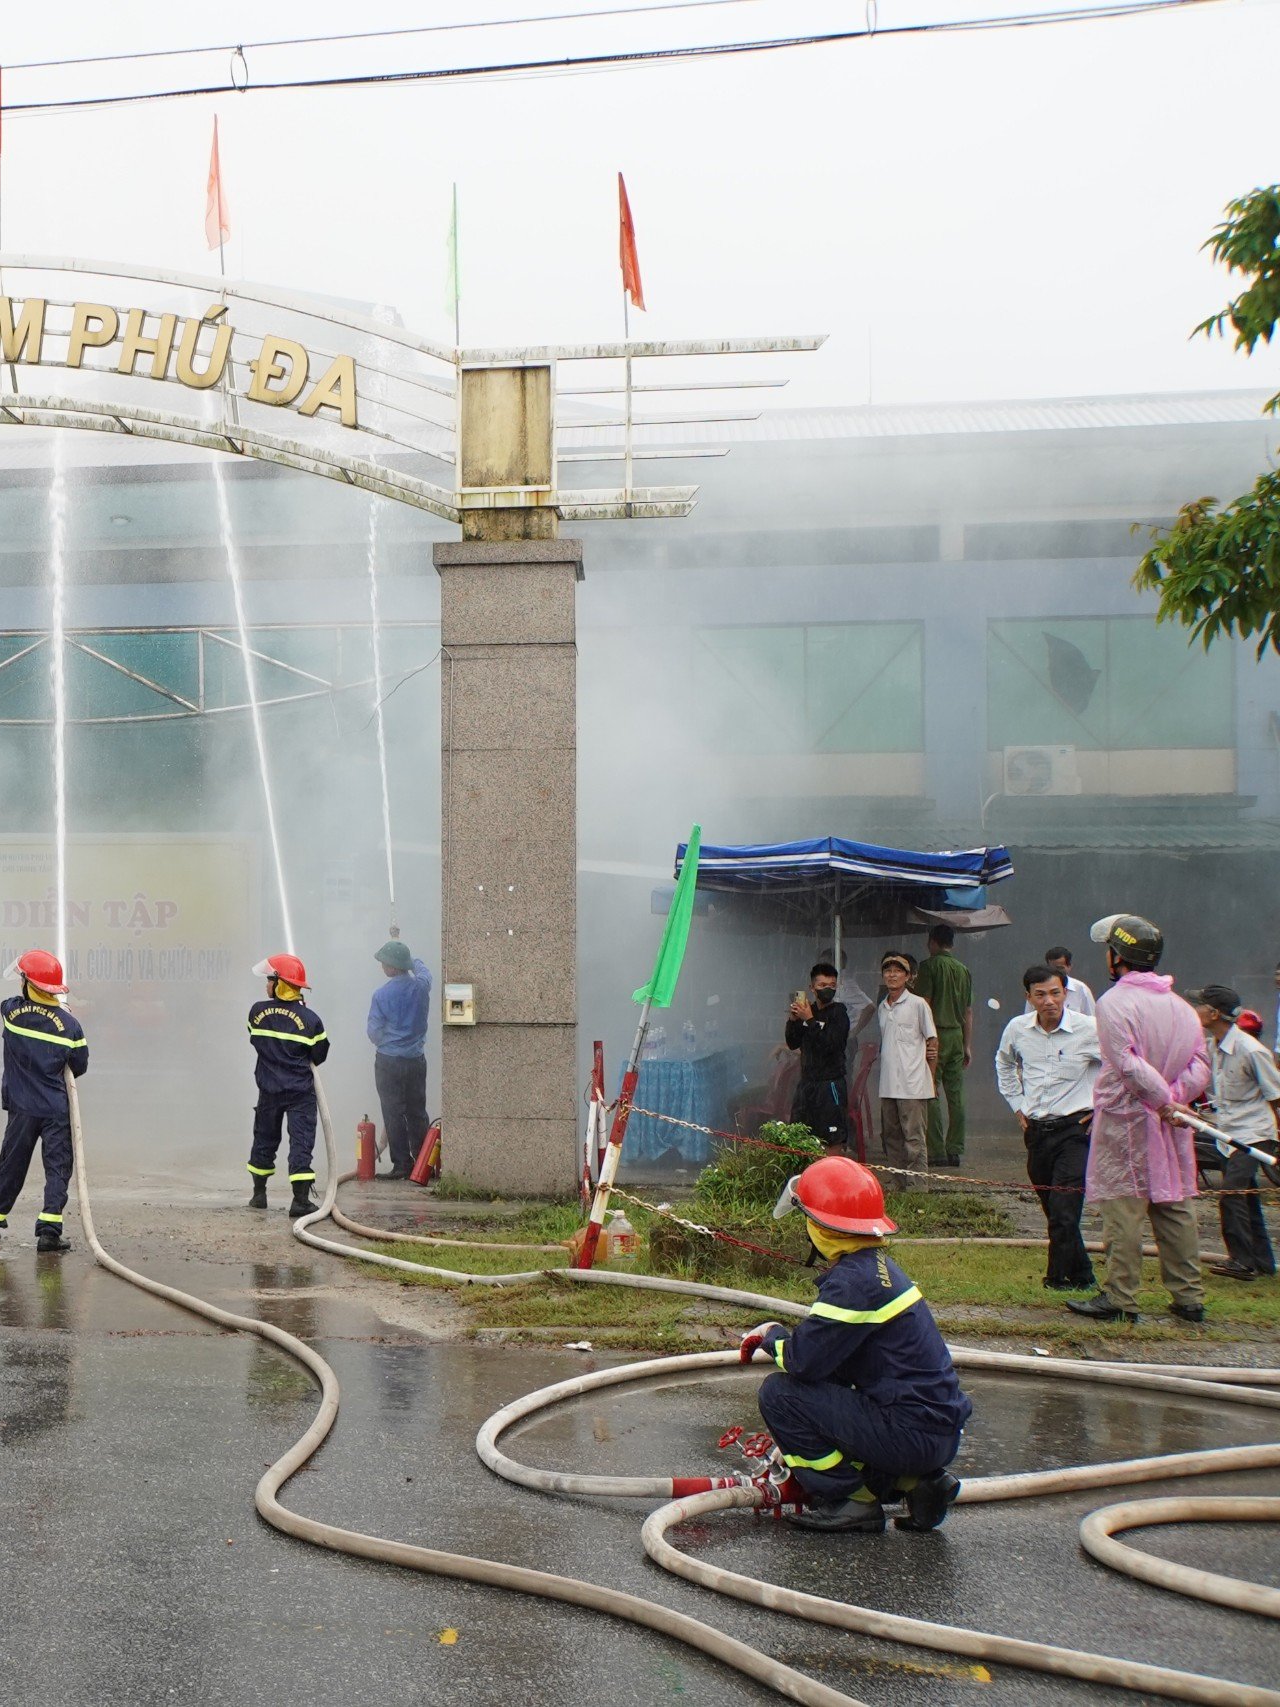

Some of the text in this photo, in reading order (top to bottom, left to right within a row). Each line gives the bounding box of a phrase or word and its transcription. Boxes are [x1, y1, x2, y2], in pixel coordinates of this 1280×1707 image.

[66, 302, 235, 391] PHÚ
[246, 333, 358, 430] ĐA
[103, 892, 178, 936] TẬP
